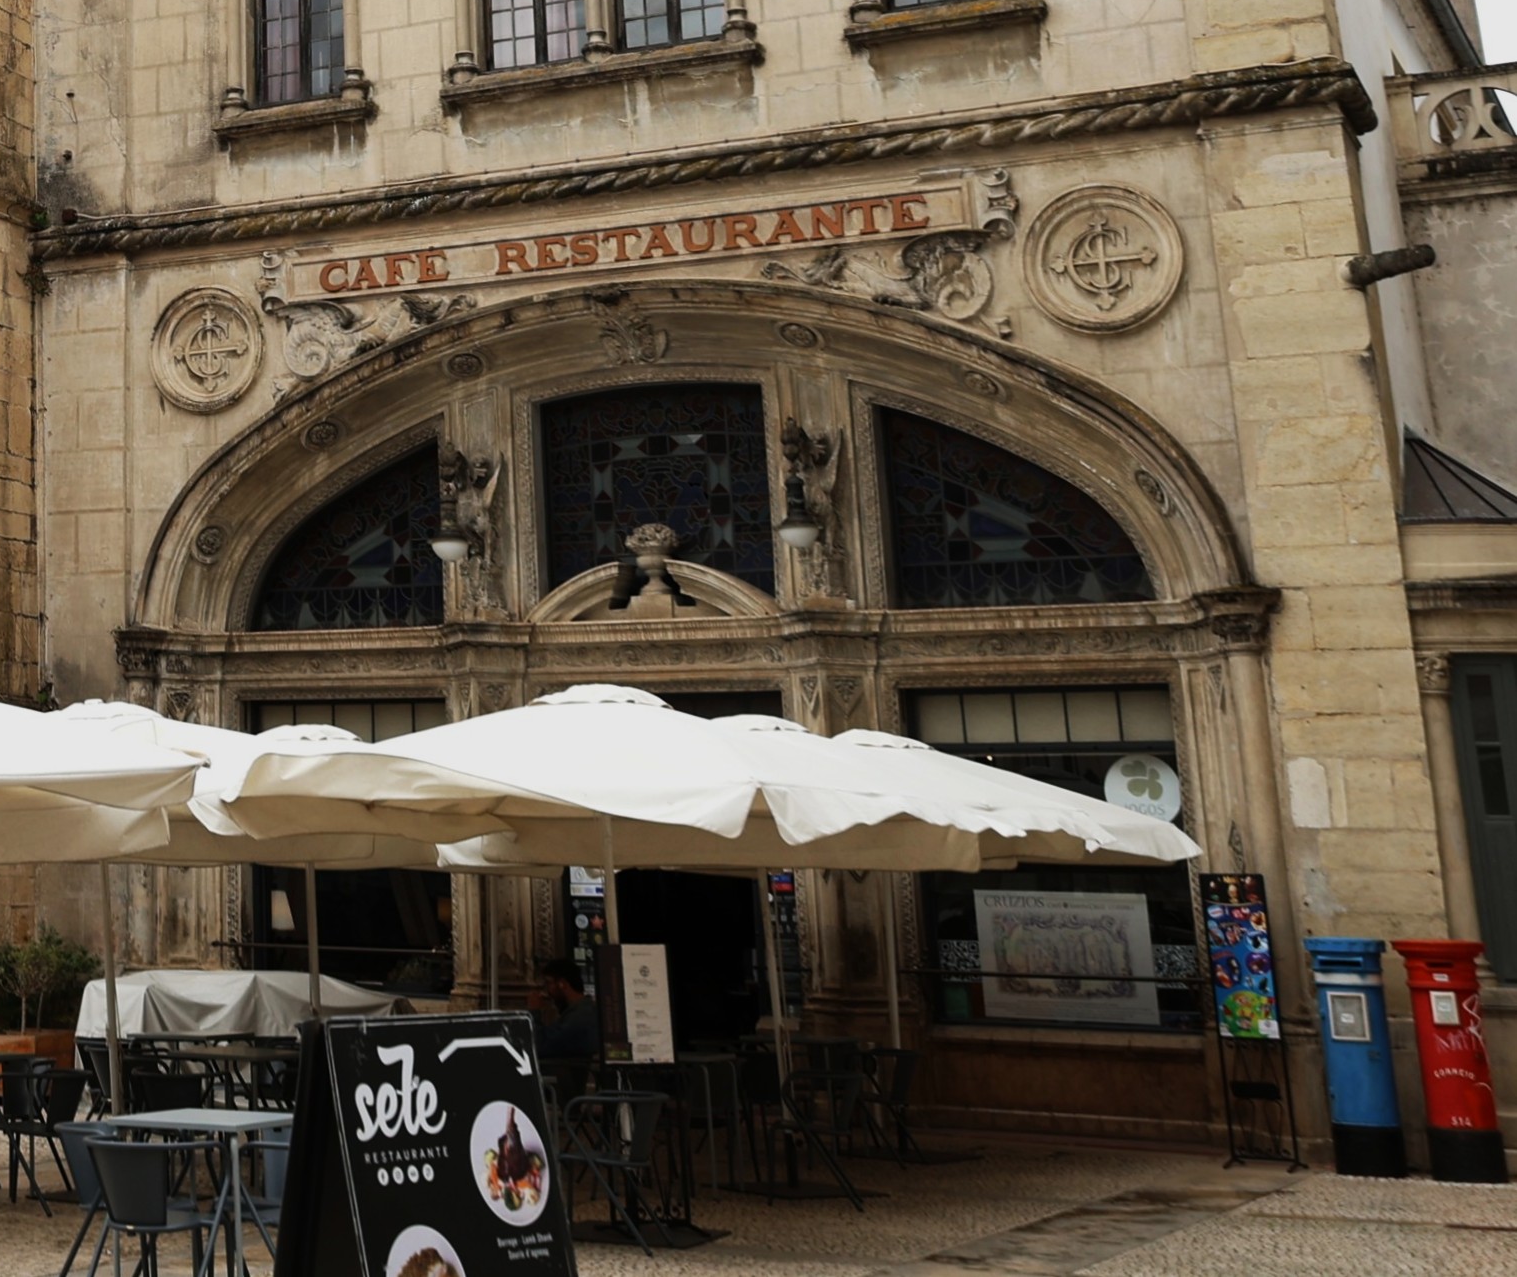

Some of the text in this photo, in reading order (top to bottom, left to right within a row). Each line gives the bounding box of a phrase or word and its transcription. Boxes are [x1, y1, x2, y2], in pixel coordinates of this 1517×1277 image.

[319, 194, 931, 293] CAFE RESTAURANTE
[364, 1145, 449, 1164] RESTAURANTE
